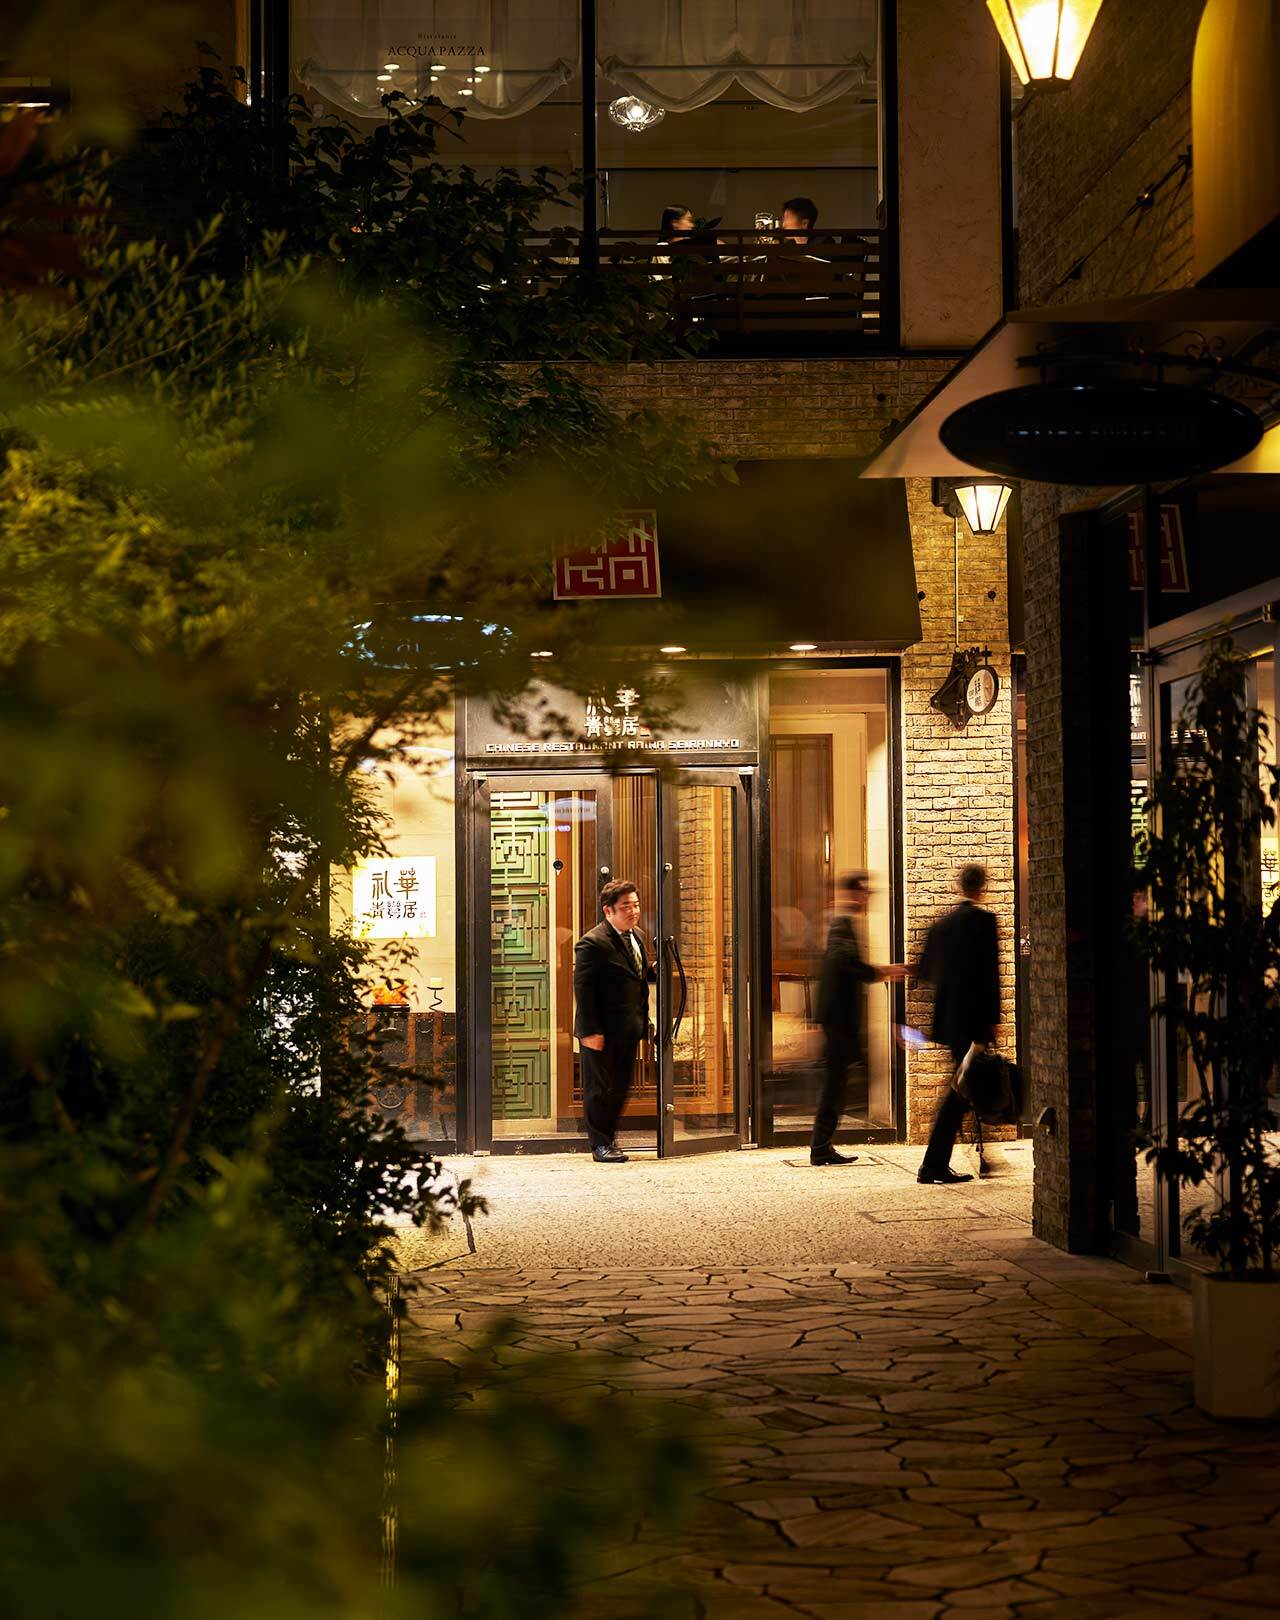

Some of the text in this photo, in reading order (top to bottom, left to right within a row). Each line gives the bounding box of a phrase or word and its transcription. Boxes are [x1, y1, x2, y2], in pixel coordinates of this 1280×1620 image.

[388, 46, 486, 57] ACQUA PAZZA
[485, 742, 540, 753] CHINESE
[371, 866, 420, 901] 礼華
